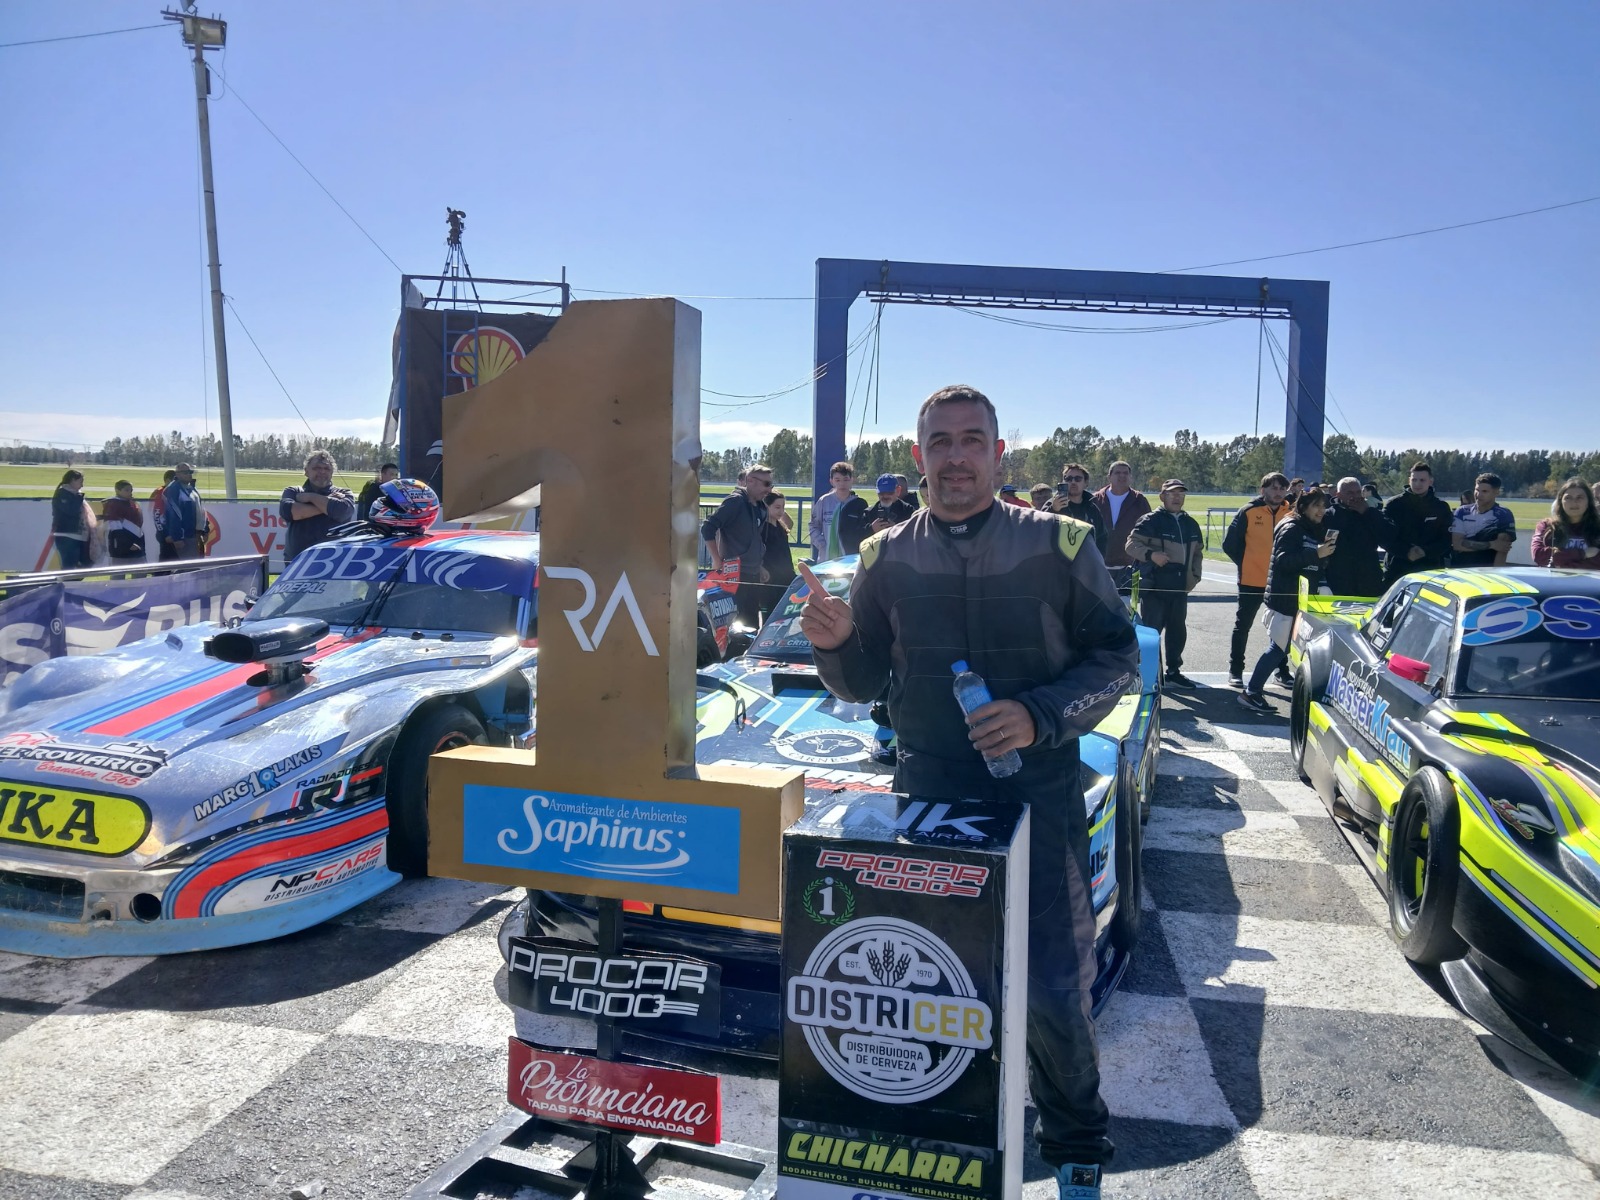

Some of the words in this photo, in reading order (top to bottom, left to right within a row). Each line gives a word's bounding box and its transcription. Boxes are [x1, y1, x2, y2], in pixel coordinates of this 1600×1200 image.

[950, 524, 968, 534] OMP
[267, 581, 327, 595] INDEPAL
[0, 747, 153, 775] ERROVIARIO
[788, 752, 849, 763] CARNES
[37, 761, 97, 778] Brandsen
[101, 772, 141, 787] 1365
[296, 762, 371, 789] RADIADORES
[497, 795, 673, 854] Saphirus
[549, 799, 614, 818] Aromatizante
[617, 804, 630, 818] de
[631, 806, 687, 824] Ambientes
[914, 830, 984, 842] AIRES
[264, 878, 333, 901] DISTRIBUIDORA
[338, 857, 379, 880] AUTOMOTIVE
[270, 842, 384, 892] NPCARS
[817, 851, 988, 884] PROCAR
[509, 945, 708, 994] PROCAR
[845, 960, 861, 969] EST.
[916, 969, 933, 979] 1970
[794, 984, 985, 1041] DISTRICER
[847, 1041, 924, 1061] DISTRIBUIDORA
[856, 1054, 868, 1065] DE
[871, 1056, 917, 1072] CERVEZA
[566, 1058, 590, 1082] La
[520, 1059, 712, 1126] Provinciana
[526, 1097, 567, 1114] TAPAS
[569, 1106, 604, 1121] PARA
[607, 1113, 695, 1136] EMPANADAS
[787, 1132, 983, 1188] CHICHARRA
[782, 1166, 848, 1182] RODAMIENTOS
[858, 1177, 901, 1190] BULONES
